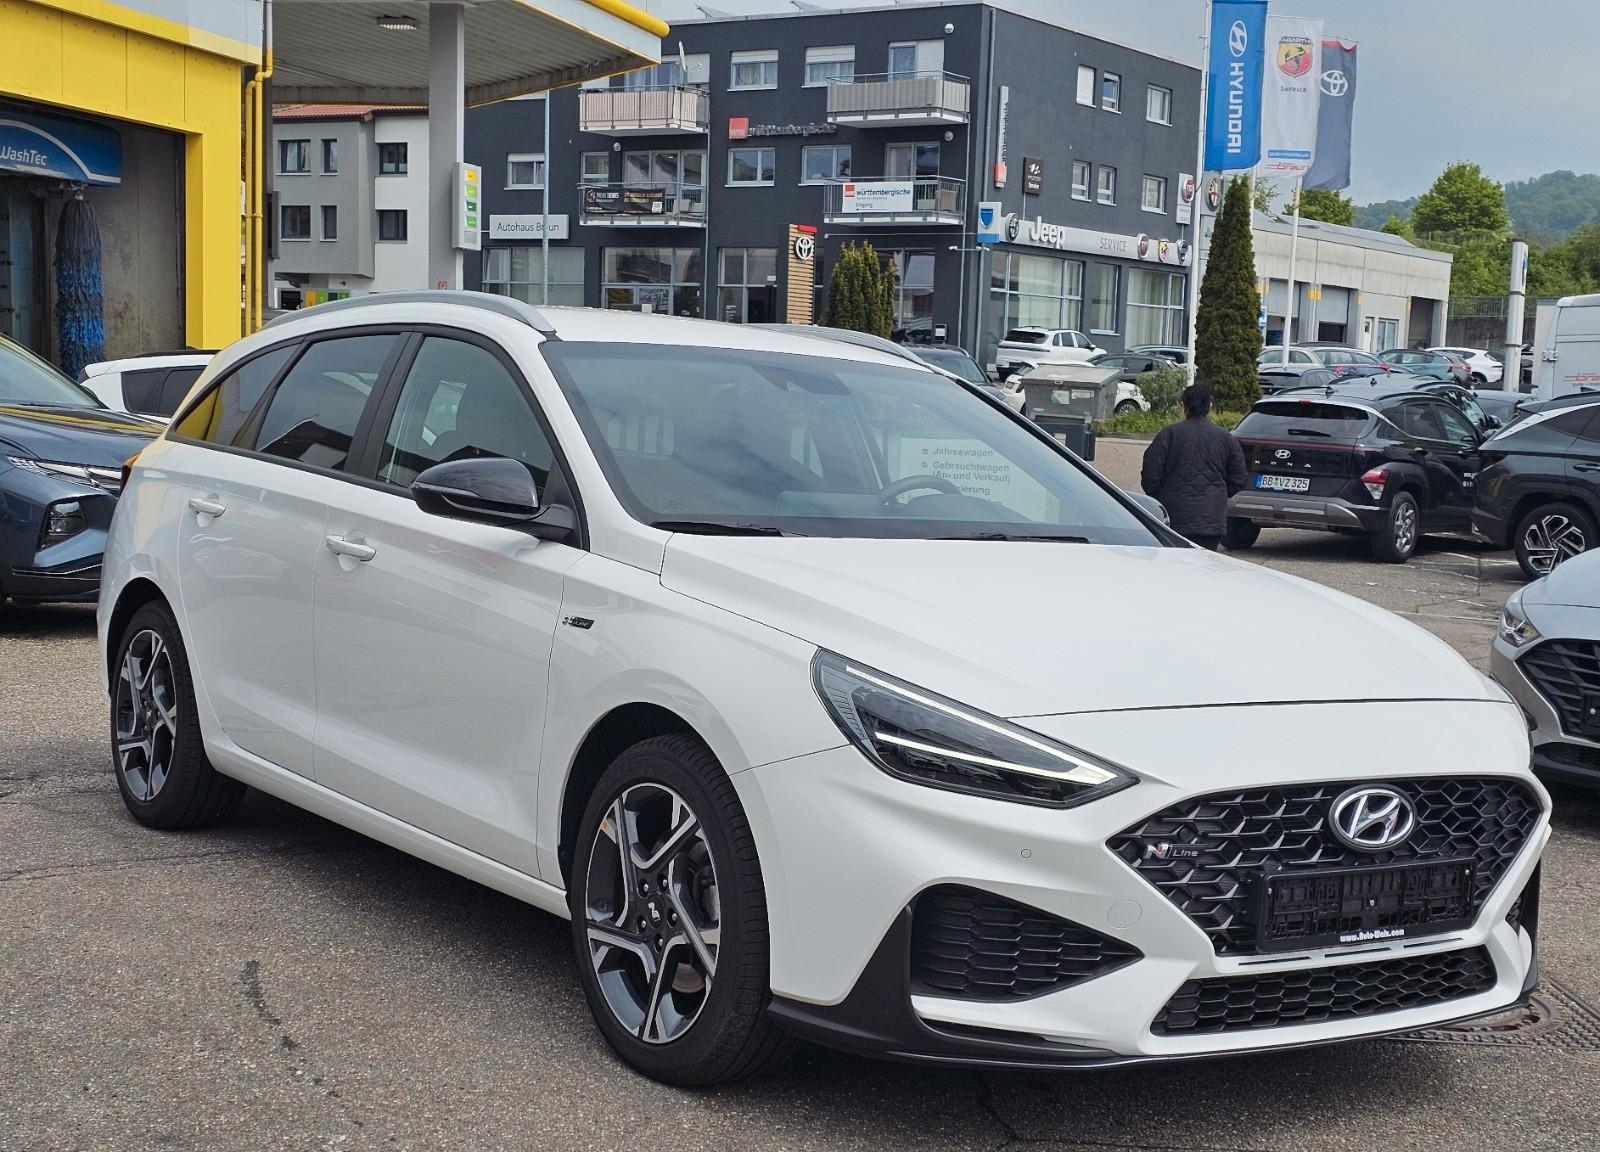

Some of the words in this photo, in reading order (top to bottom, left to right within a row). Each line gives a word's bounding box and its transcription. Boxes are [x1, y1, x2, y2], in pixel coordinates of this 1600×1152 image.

[1227, 62, 1244, 153] HYUNDAI
[497, 222, 534, 232] Autohaus
[536, 222, 560, 232] Brun
[1030, 216, 1066, 249] Jeep
[1100, 238, 1127, 253] SERVICE
[933, 448, 993, 457] Jahreswagen
[932, 461, 1010, 473] Gebrauchtwagen
[953, 472, 971, 480] und
[974, 473, 1011, 484] Verkauf)
[1291, 479, 1308, 489] 325
